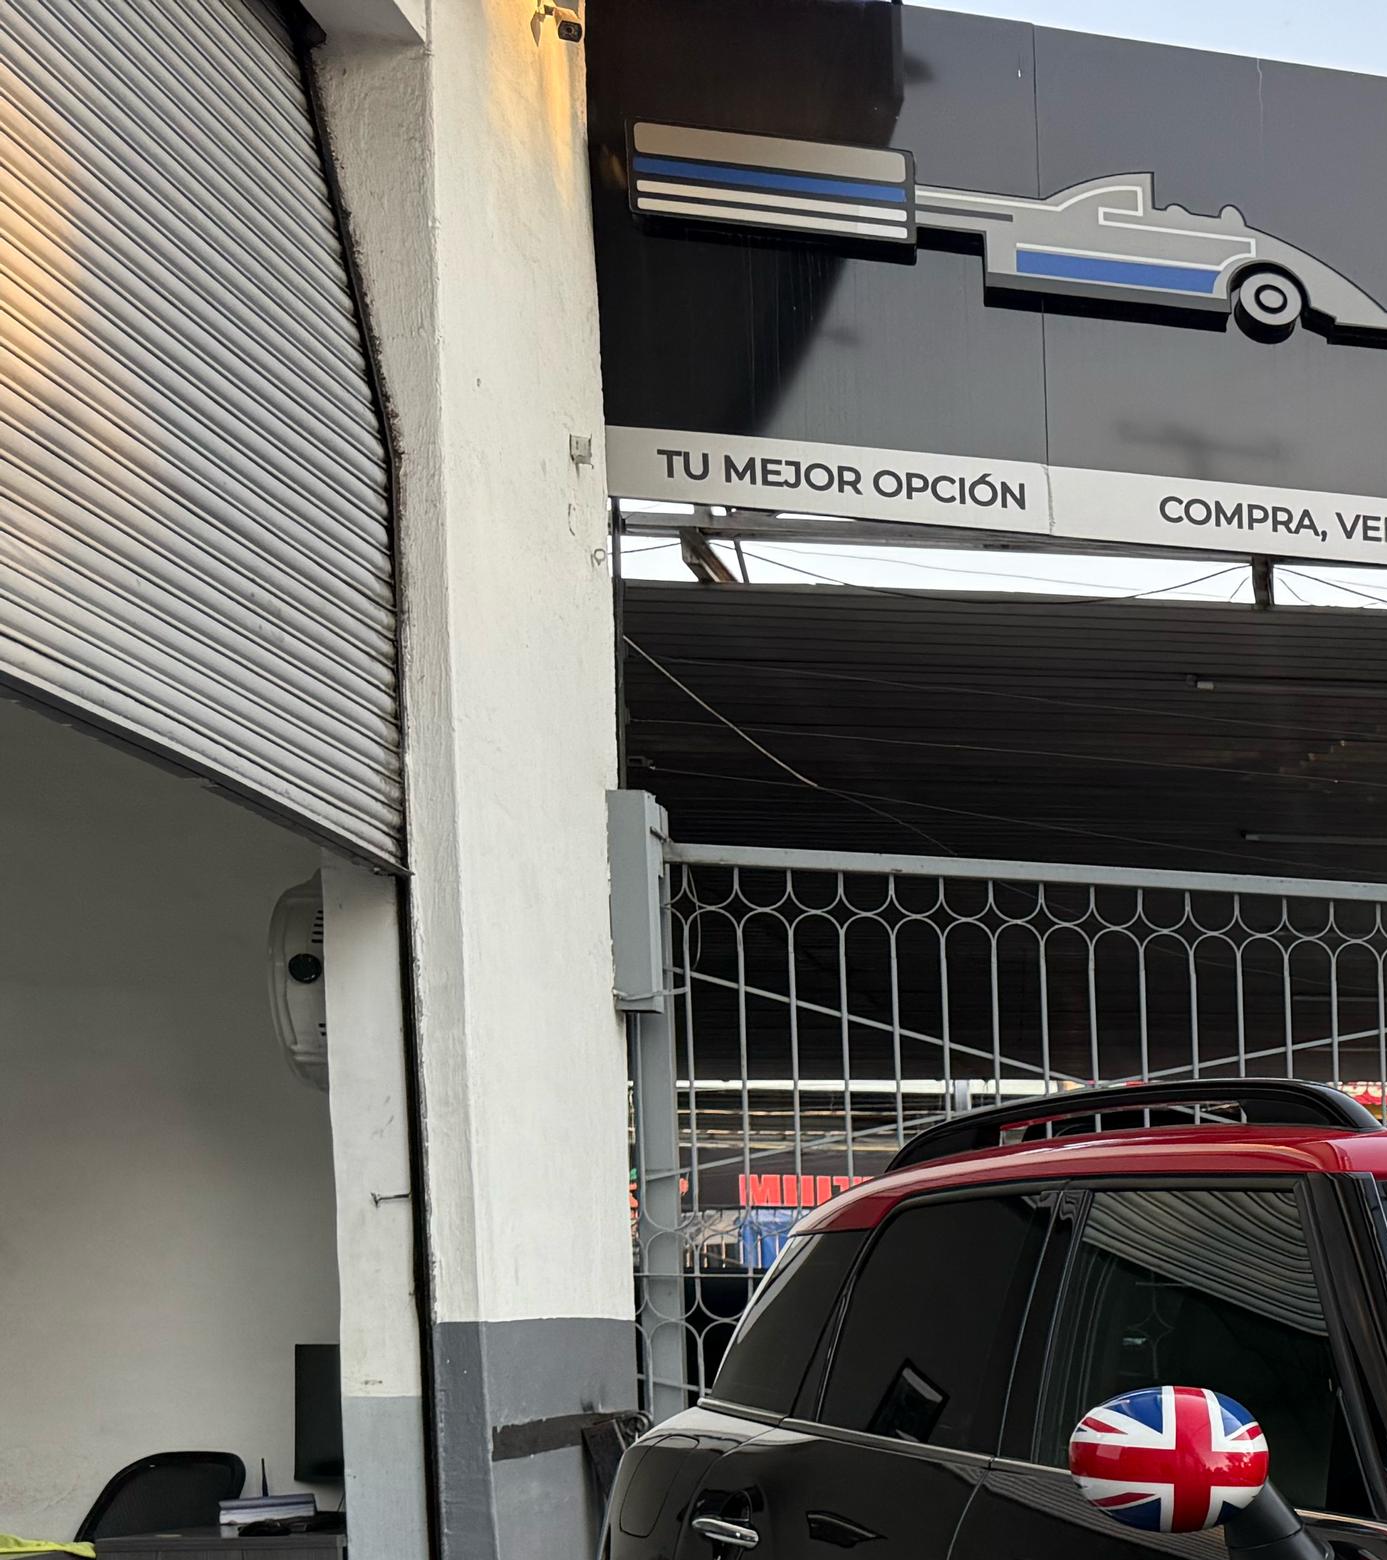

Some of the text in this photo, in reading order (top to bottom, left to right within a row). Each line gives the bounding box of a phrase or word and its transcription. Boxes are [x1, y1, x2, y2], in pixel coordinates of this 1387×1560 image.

[656, 449, 1027, 511] TU MEJOR OPCIÓN
[1158, 495, 1329, 543] COMPRA,
